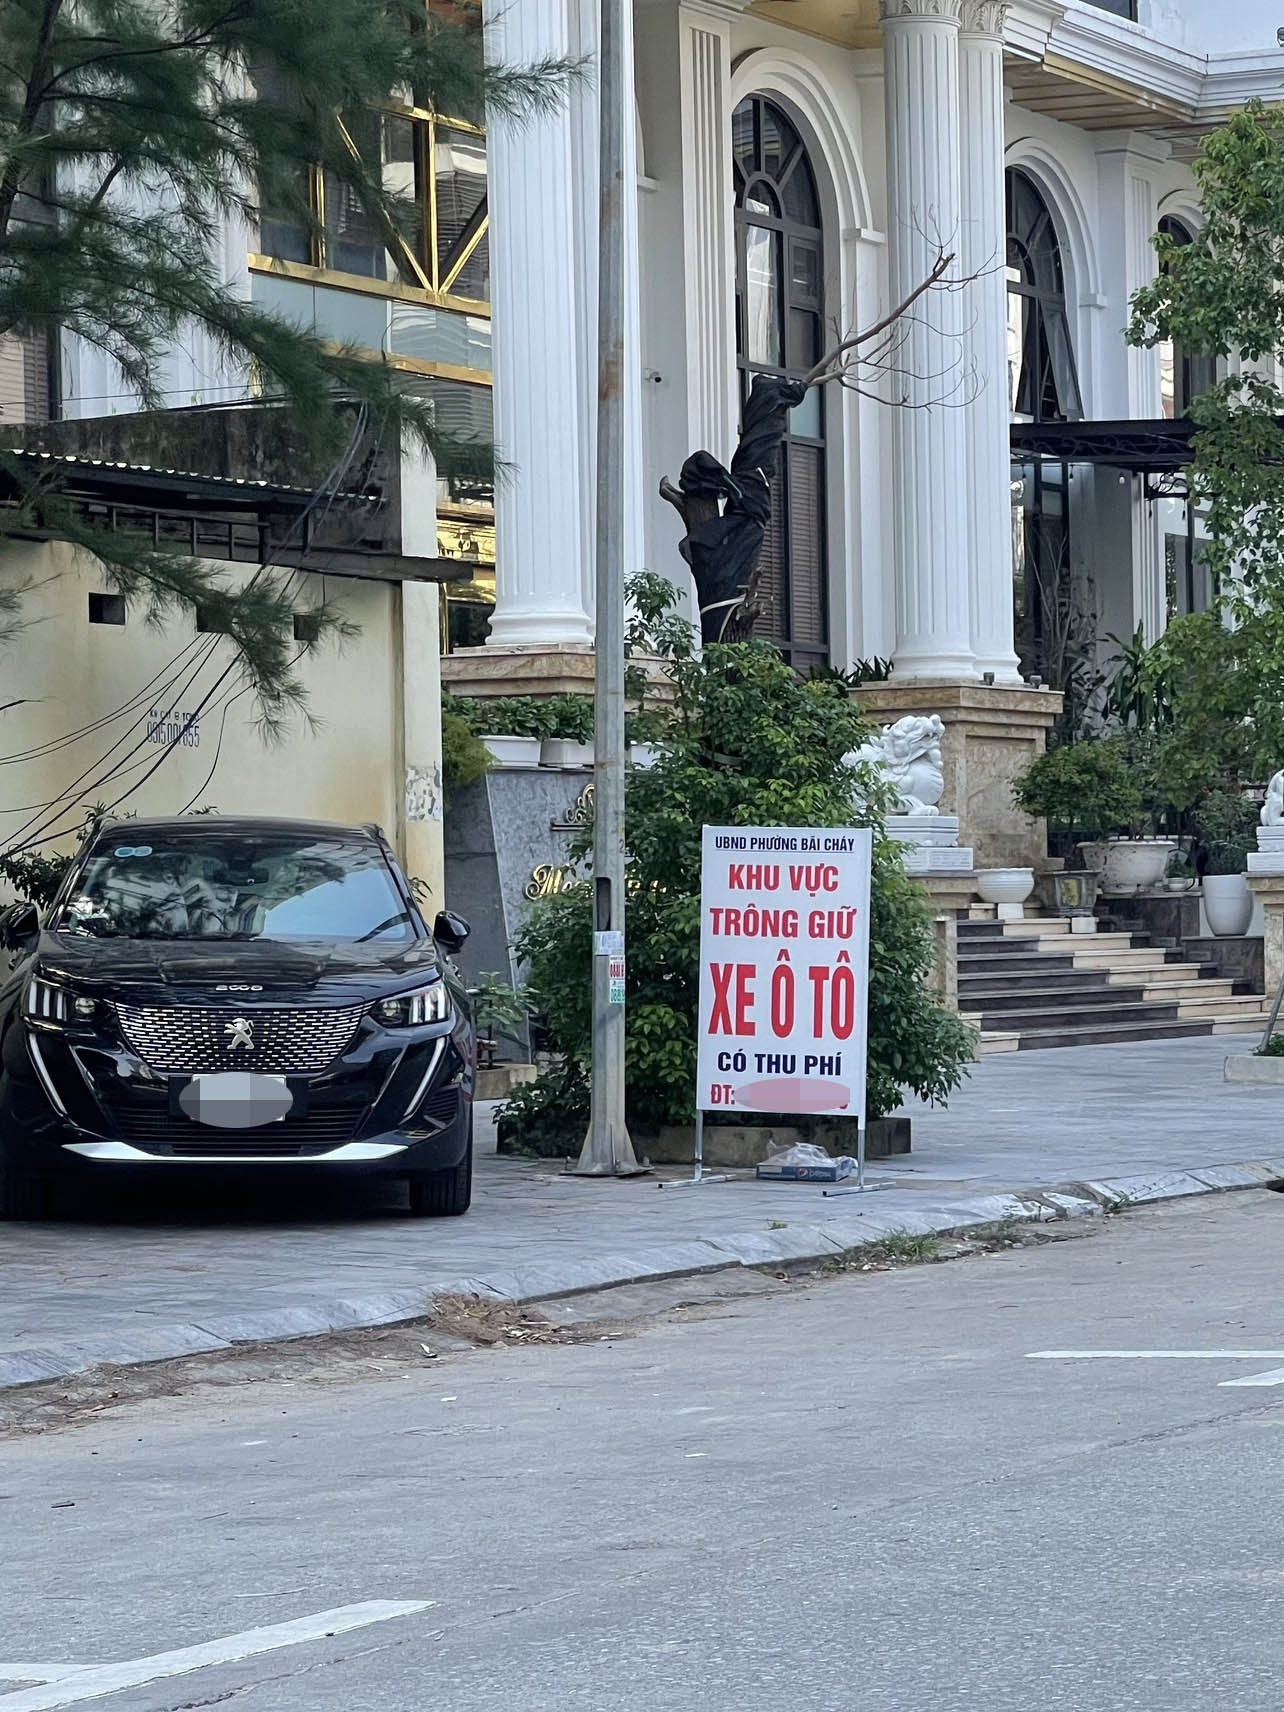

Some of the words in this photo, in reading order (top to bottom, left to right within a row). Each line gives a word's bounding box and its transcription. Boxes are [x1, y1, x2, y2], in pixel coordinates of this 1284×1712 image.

[715, 836, 747, 849] UBND
[750, 835, 797, 850] PHƯỜNG
[801, 835, 820, 851] BÃI
[824, 835, 855, 851] CHÁY
[729, 864, 780, 890] KHU
[789, 863, 839, 897] VỰC
[710, 903, 799, 938] TRÔNG
[808, 905, 858, 940] GIỮ
[708, 962, 757, 1037] XE
[771, 949, 795, 1039] Ô
[809, 950, 855, 1041] TÔ
[718, 1048, 747, 1073] CÓ
[754, 1053, 796, 1075] THU
[804, 1052, 842, 1076] PHÍ
